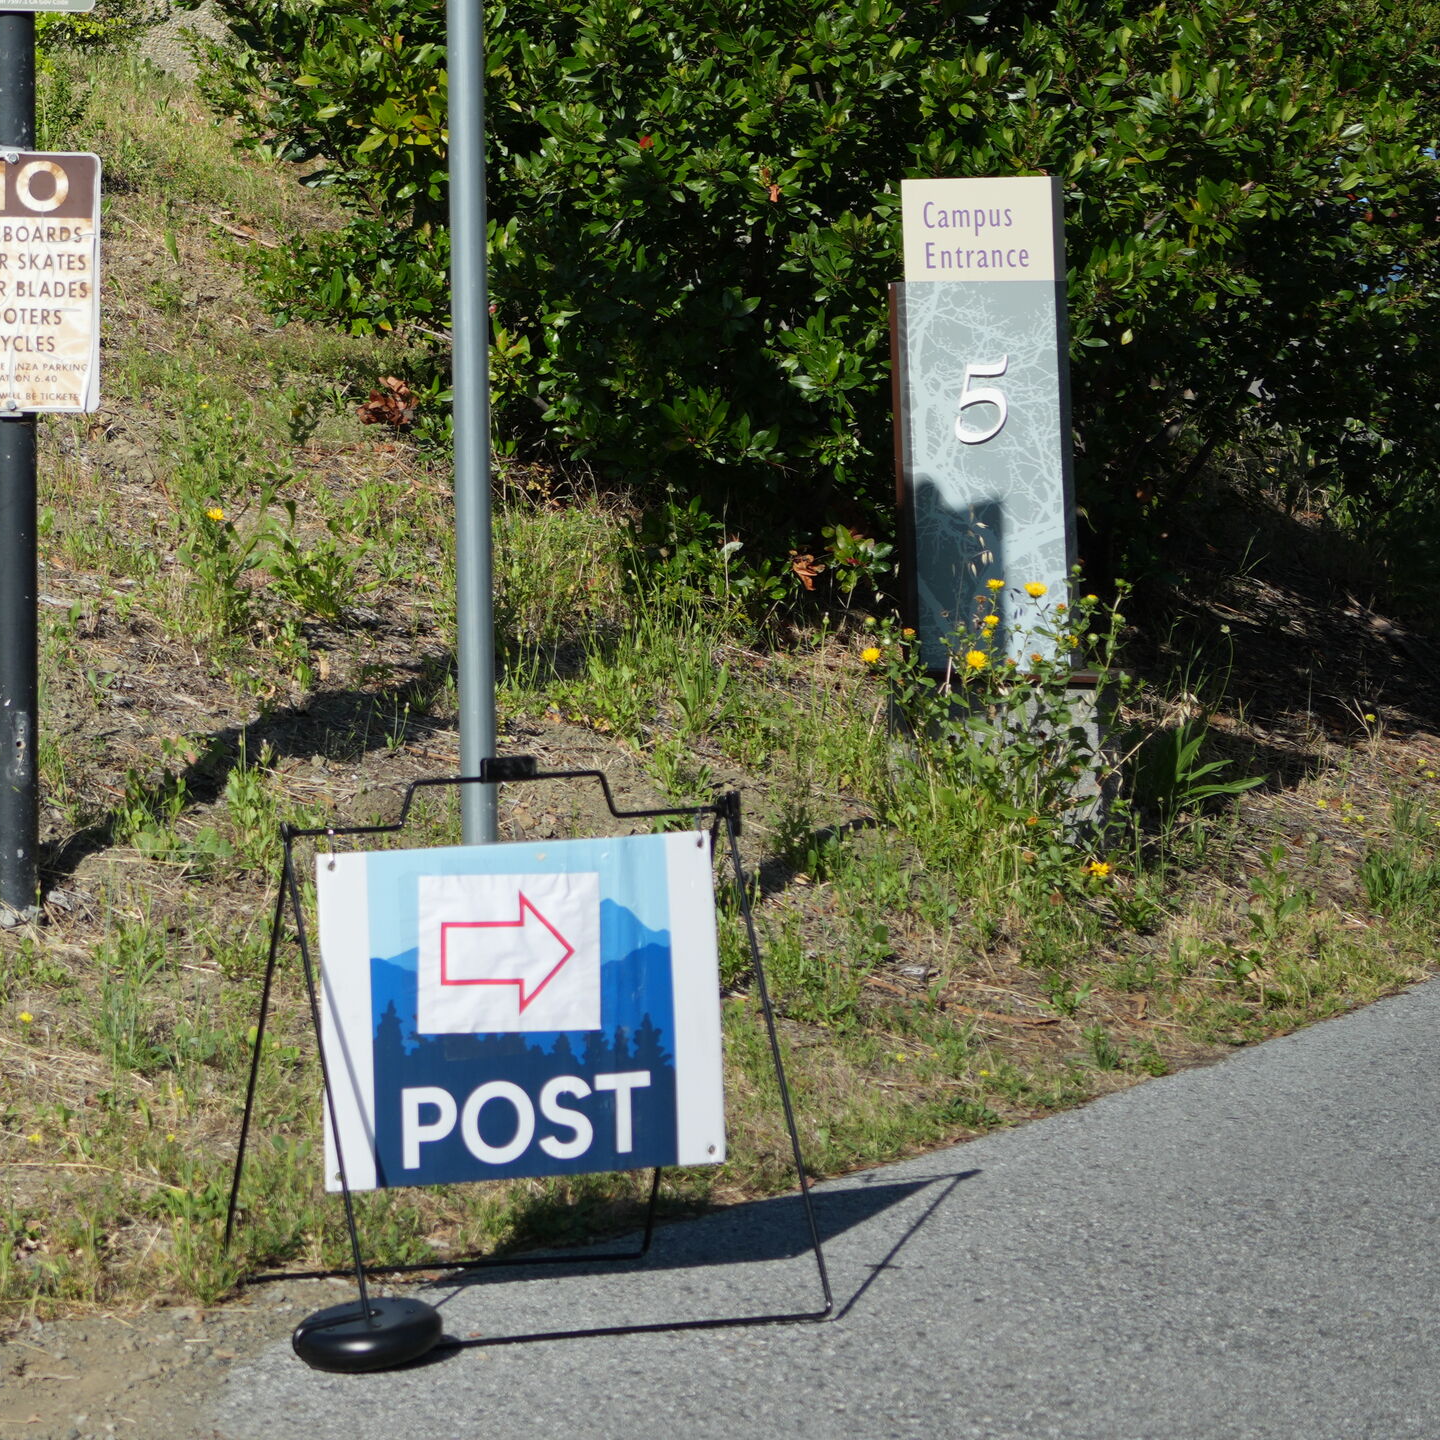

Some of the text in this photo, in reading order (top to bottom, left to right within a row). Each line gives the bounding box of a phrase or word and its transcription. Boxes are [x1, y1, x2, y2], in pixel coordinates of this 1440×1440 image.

[923, 201, 1013, 237] Campus
[18, 253, 86, 271] SKATES
[925, 241, 1030, 269] Entrance
[16, 281, 88, 298] BLADES
[14, 362, 39, 371] NZA
[34, 374, 58, 383] 6.40
[25, 392, 37, 400] BE
[954, 353, 1009, 445] 5
[401, 1070, 651, 1170] POST
